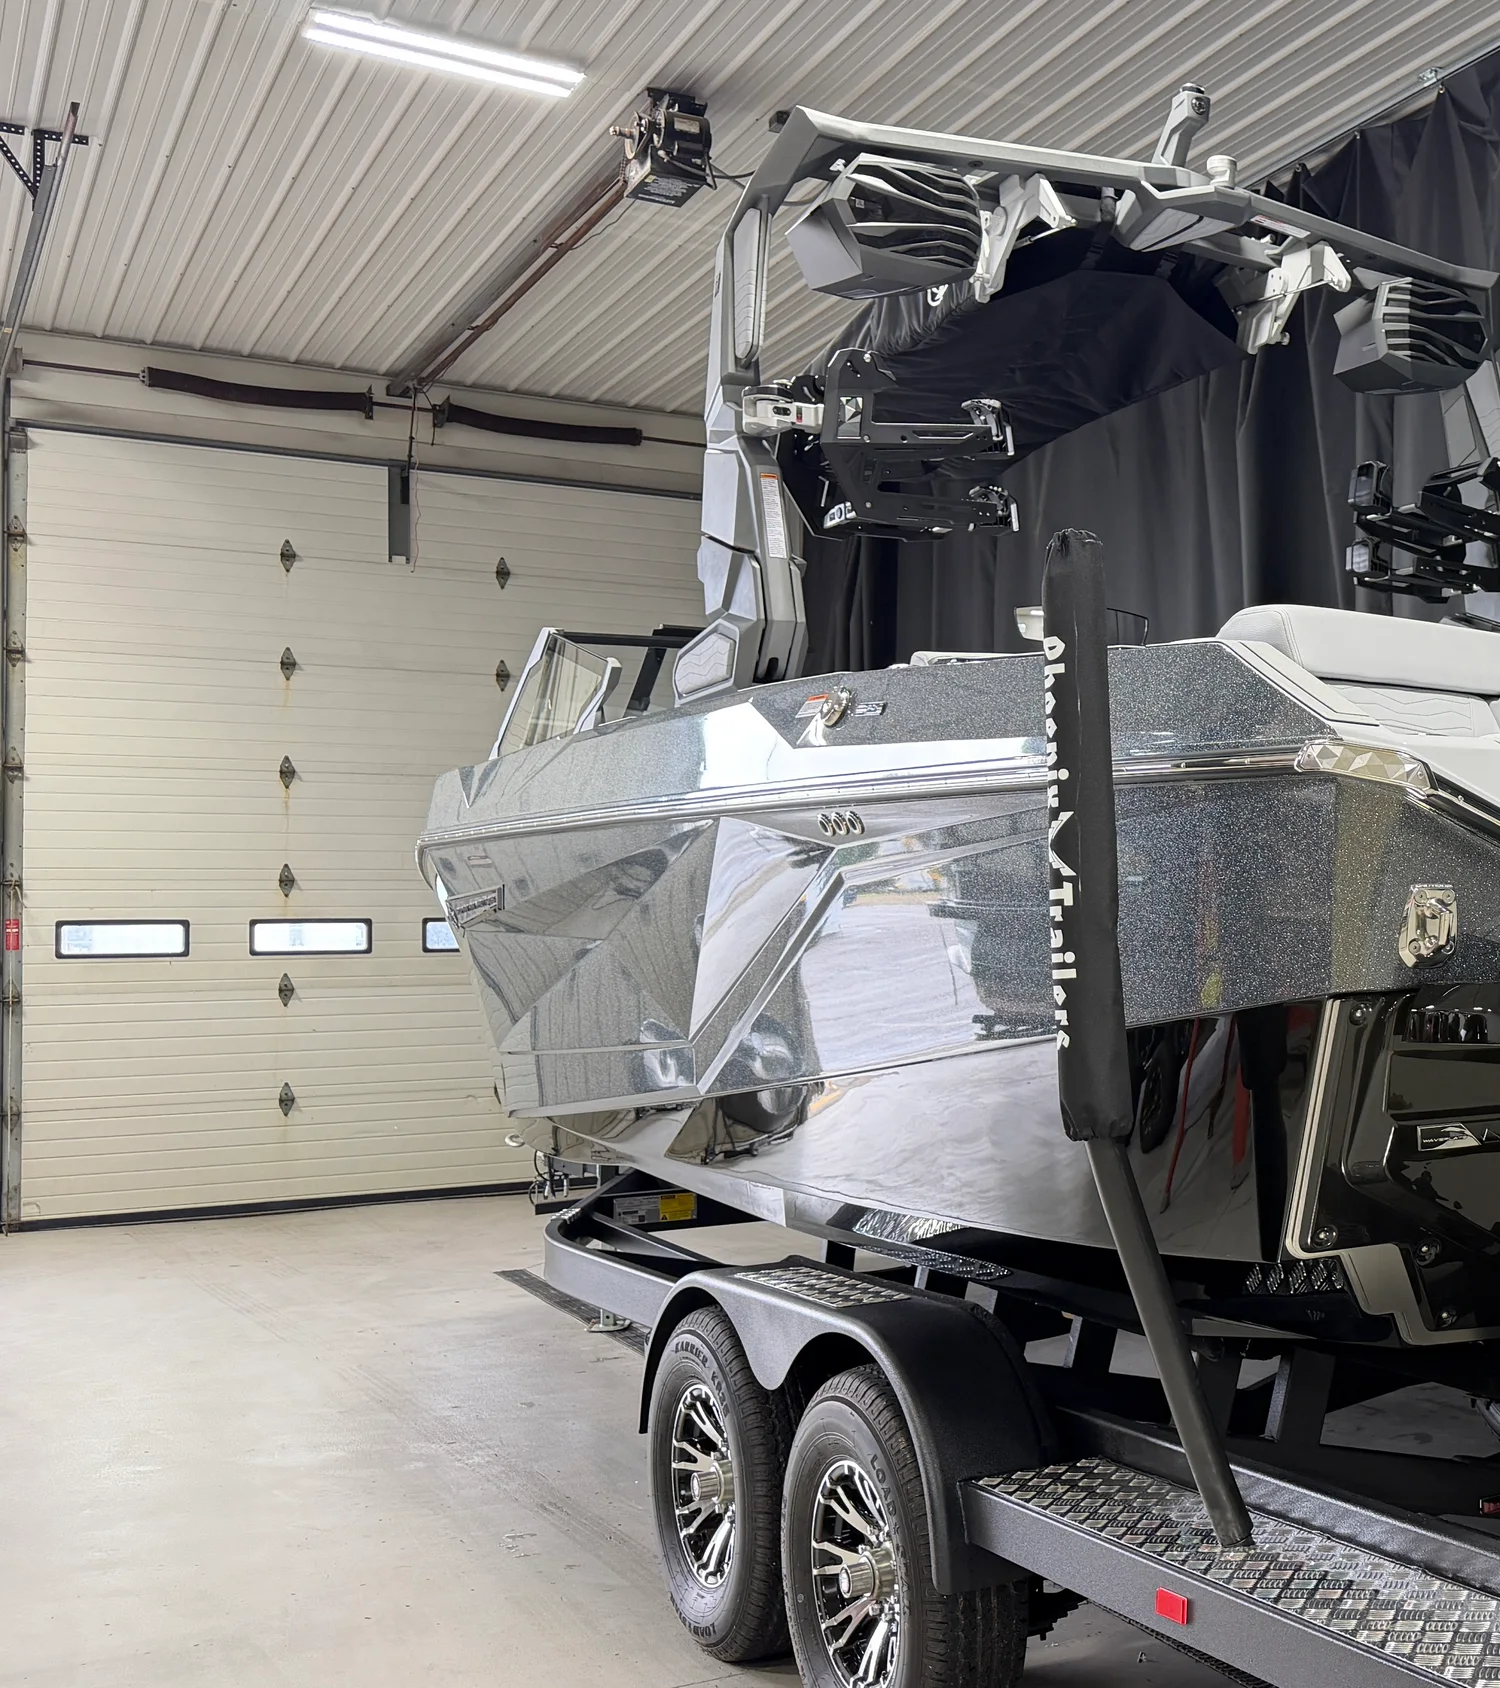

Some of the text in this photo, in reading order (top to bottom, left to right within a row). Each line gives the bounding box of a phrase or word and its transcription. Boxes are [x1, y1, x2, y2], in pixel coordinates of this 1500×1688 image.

[1049, 881, 1077, 1050] Trailers
[674, 1340, 708, 1368] KARRIER
[869, 1453, 897, 1517] LOAD
